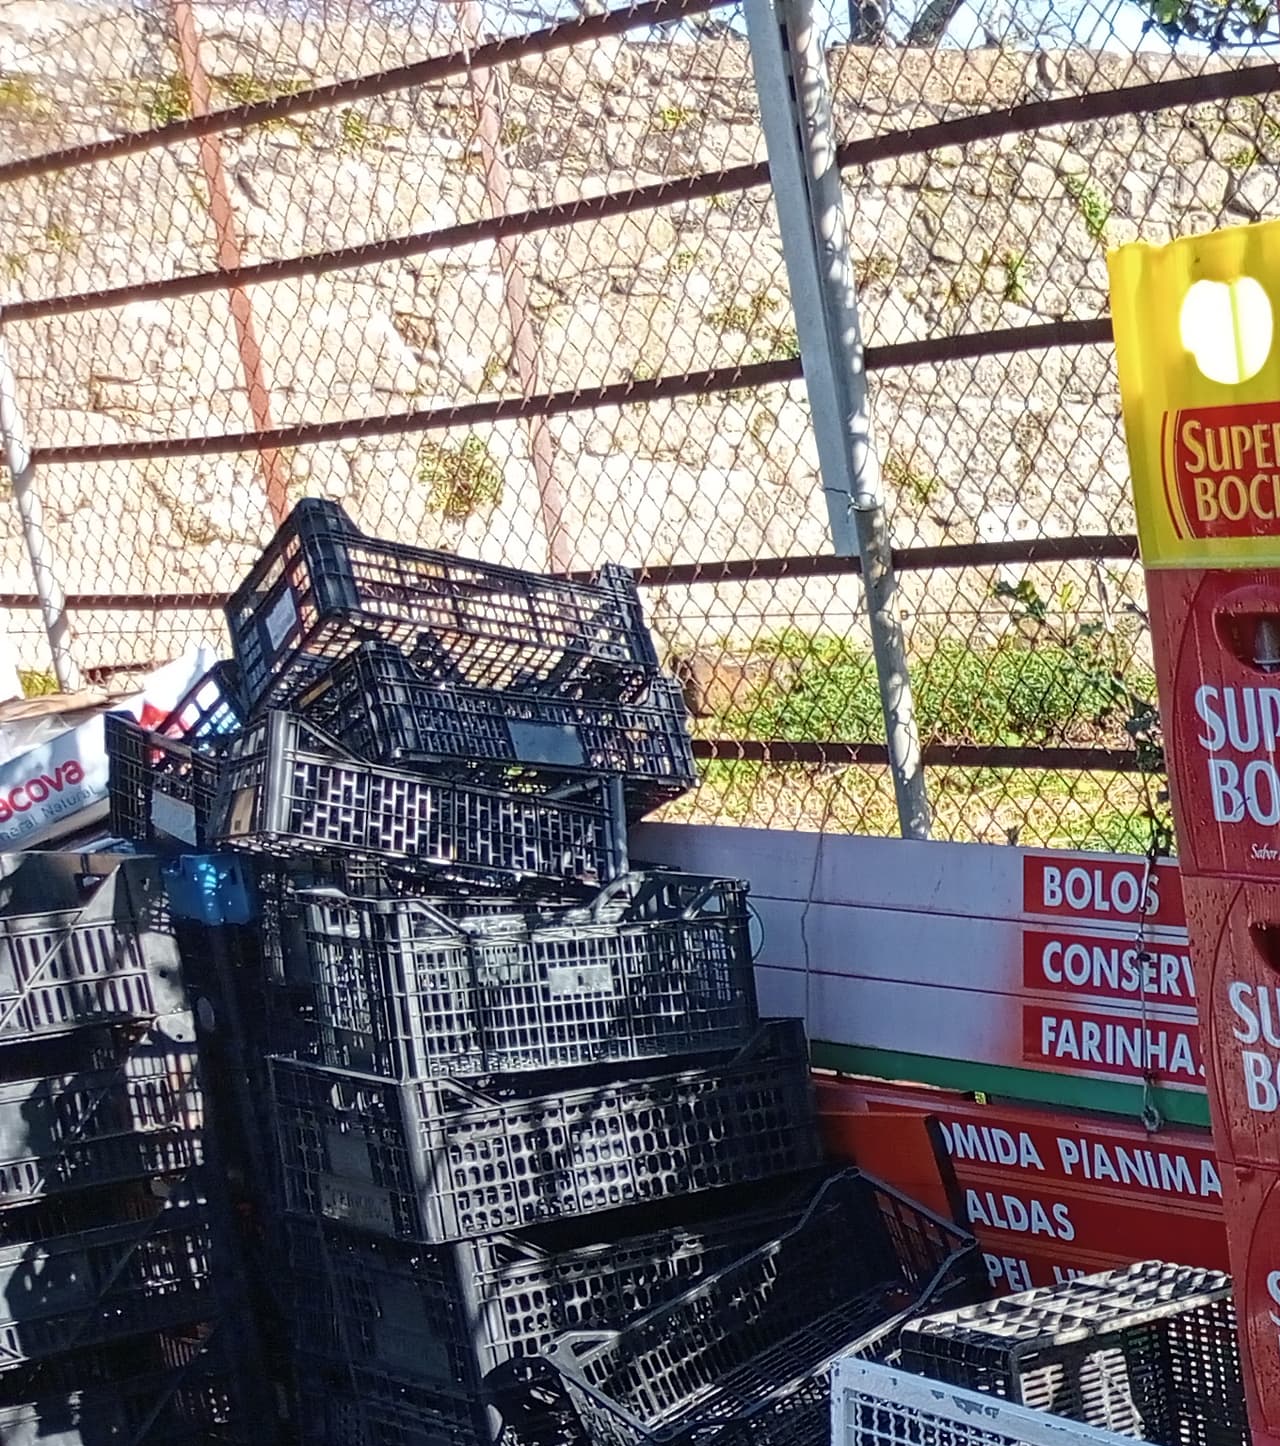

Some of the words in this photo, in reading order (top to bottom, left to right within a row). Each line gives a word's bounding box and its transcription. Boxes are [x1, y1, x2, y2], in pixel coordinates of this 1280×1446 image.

[41, 784, 96, 818] Natural
[1251, 843, 1278, 861] Sabor
[1043, 866, 1160, 916] BOLOS
[1041, 1016, 1206, 1077] FARINHA
[965, 1189, 1075, 1241] ALDAS
